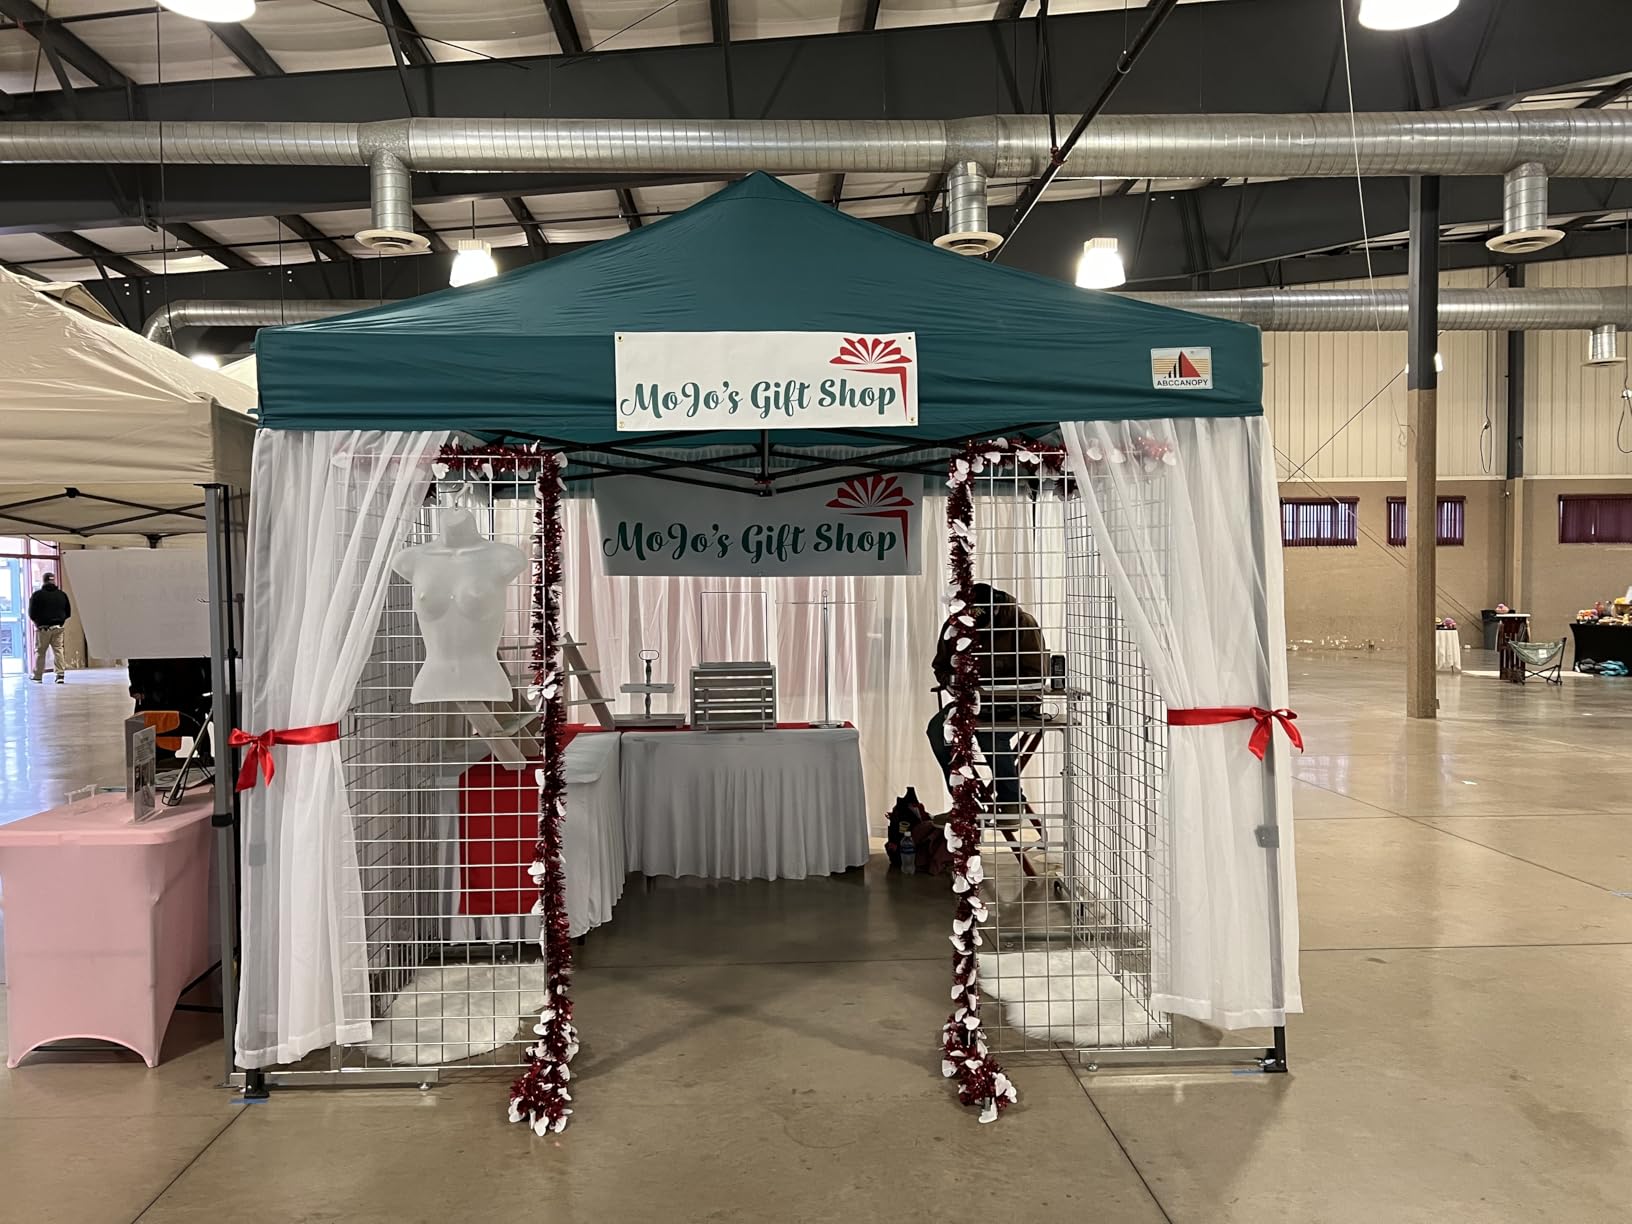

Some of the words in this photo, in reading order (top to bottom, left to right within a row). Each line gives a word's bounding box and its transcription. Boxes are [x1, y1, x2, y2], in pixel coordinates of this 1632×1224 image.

[620, 380, 743, 418] MoJo's
[750, 380, 812, 419] Gift
[818, 378, 896, 415] Shop
[602, 521, 734, 561] MoJo's
[741, 523, 807, 564] Gift
[813, 522, 897, 561] Shop
